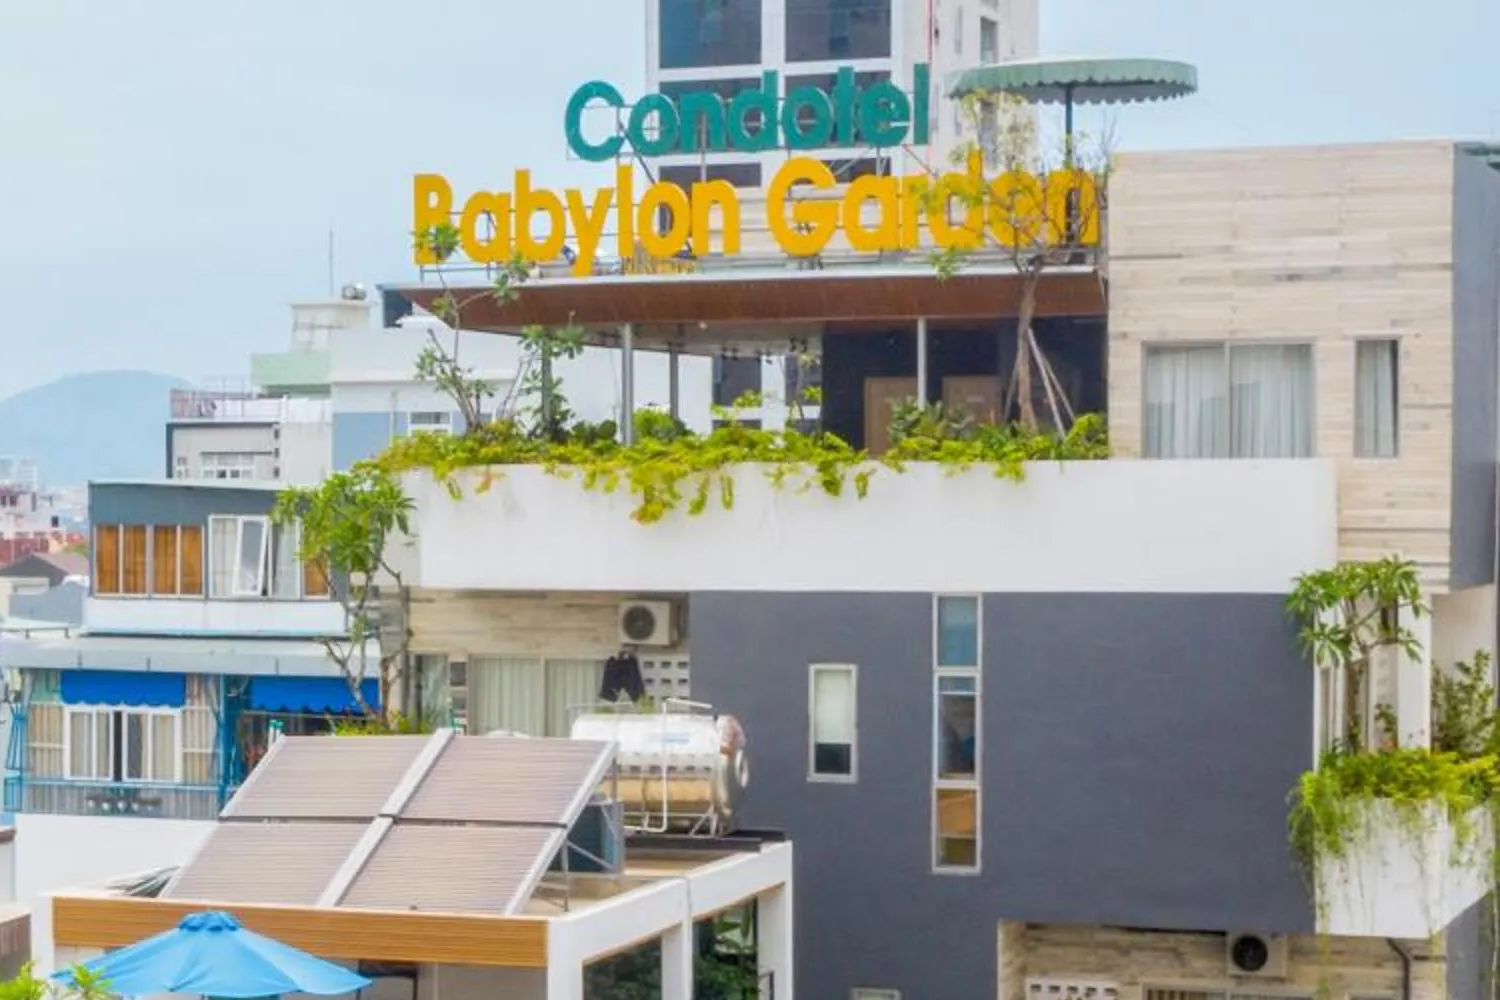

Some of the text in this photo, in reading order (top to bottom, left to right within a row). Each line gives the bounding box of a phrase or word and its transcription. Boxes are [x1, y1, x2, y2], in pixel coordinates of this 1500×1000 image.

[565, 64, 929, 162] Condotel
[413, 146, 1099, 277] Babylon Garden
